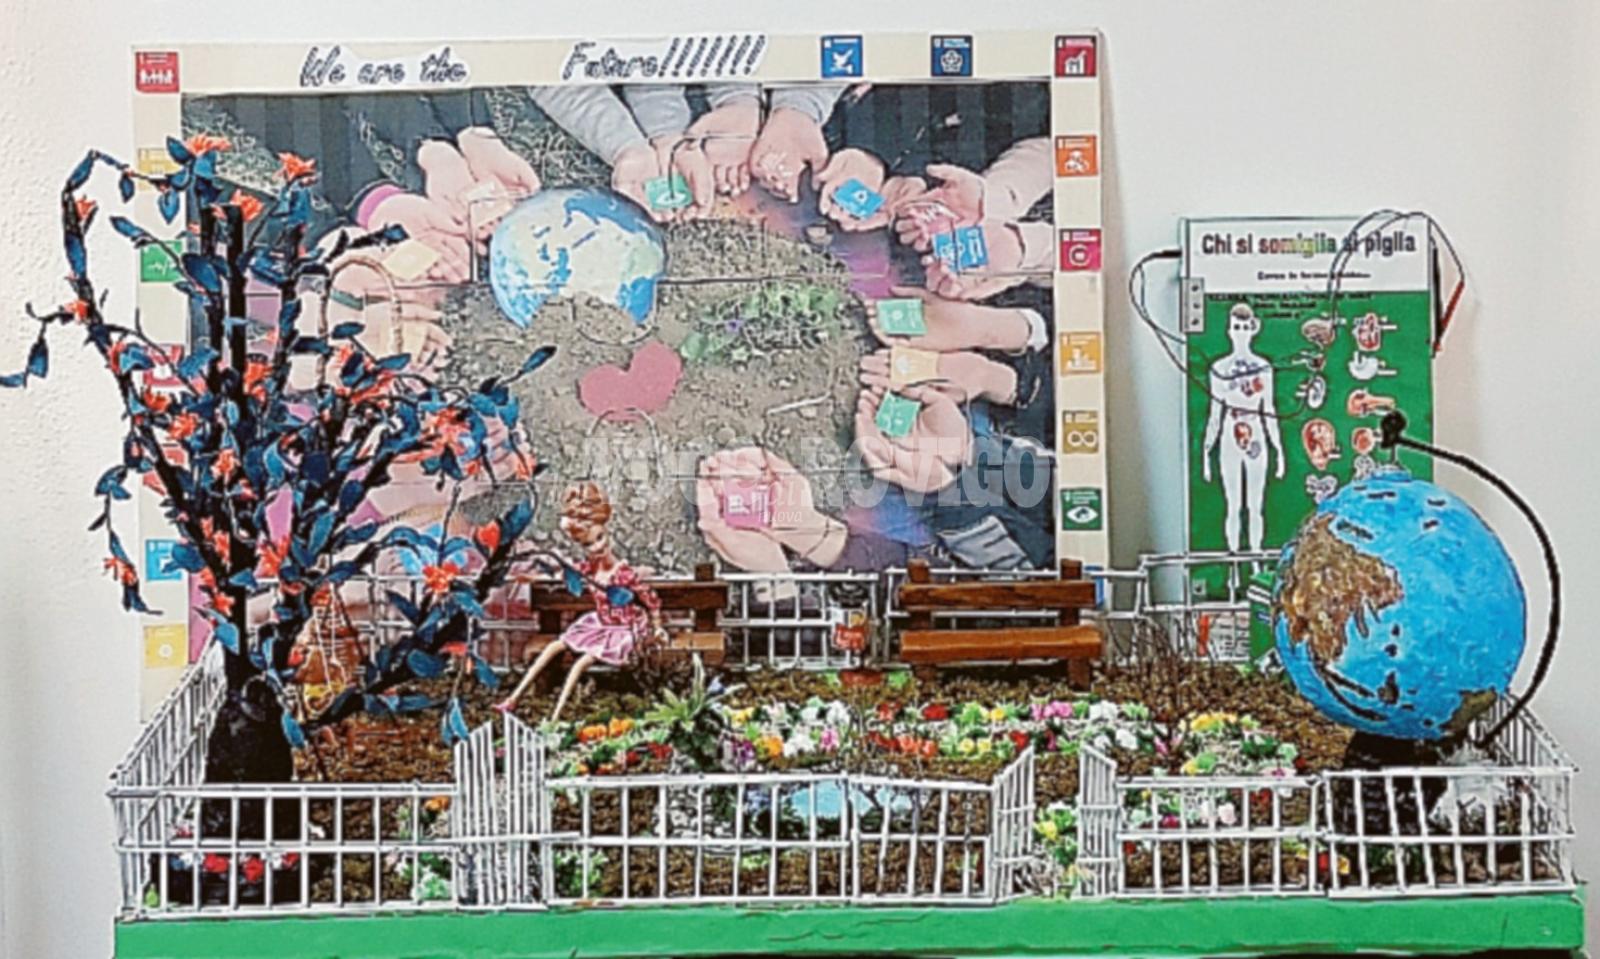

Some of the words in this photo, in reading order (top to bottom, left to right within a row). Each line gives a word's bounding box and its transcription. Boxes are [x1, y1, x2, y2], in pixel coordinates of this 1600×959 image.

[300, 45, 346, 87] We
[357, 63, 405, 84] are
[419, 46, 467, 82] the
[1202, 233, 1231, 254] Chi
[1237, 233, 1253, 254] si
[1259, 232, 1337, 258] somiglia
[1364, 231, 1416, 258] piglia
